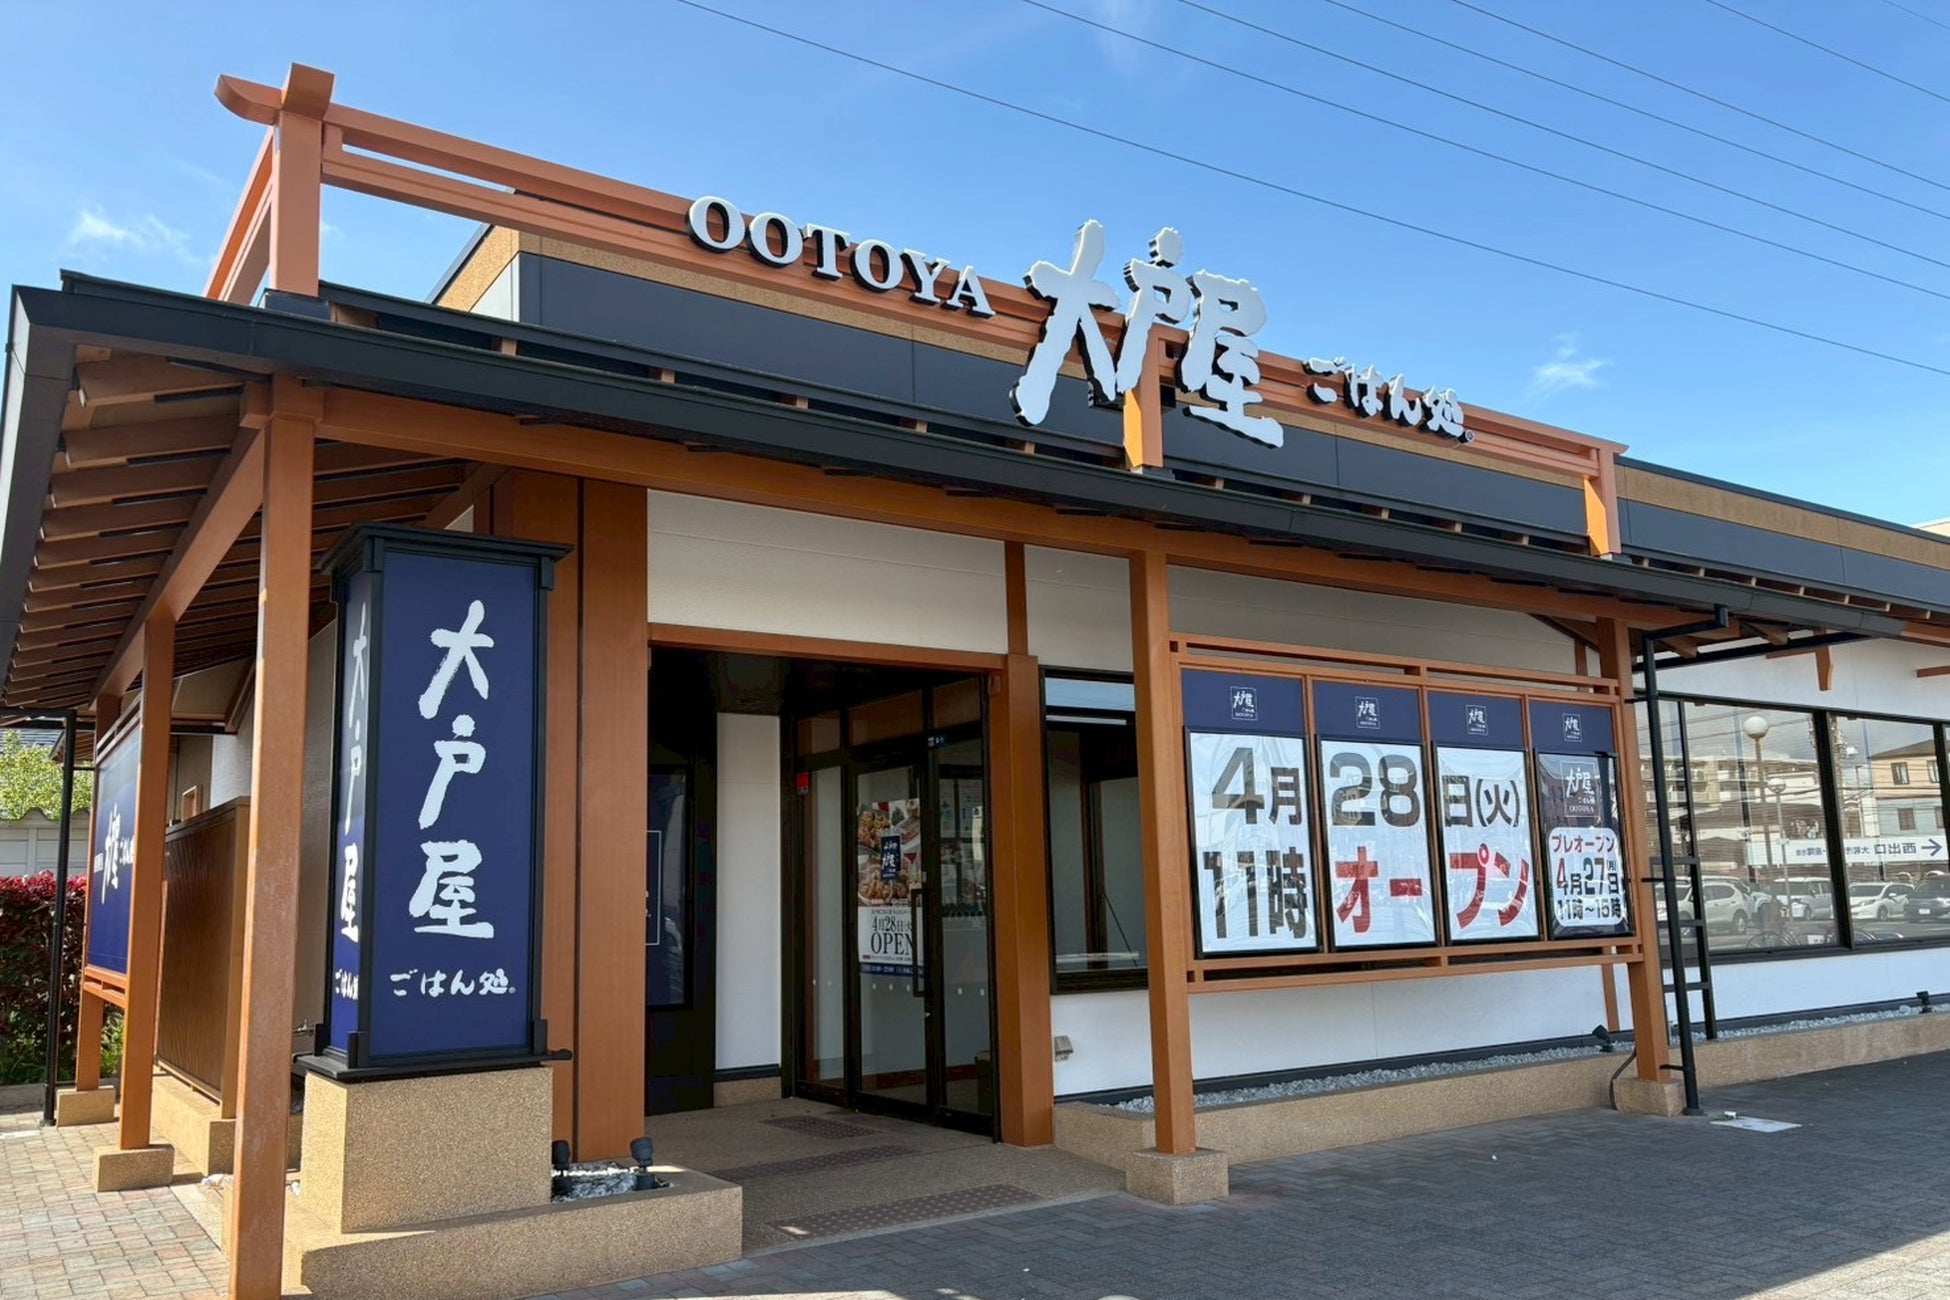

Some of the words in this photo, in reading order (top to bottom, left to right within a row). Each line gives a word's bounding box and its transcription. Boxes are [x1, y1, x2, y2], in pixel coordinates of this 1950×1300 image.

[687, 195, 996, 318] OOTOYA
[1009, 219, 1284, 448] 大戸屋
[1303, 356, 1466, 438] ごはん処
[340, 601, 367, 943] 大戸屋
[409, 600, 494, 938] 大戸屋
[1211, 747, 1302, 826] 4月
[1329, 752, 1421, 828] 28
[1441, 775, 1520, 828] 日(火)
[1203, 846, 1308, 939] 11時
[1449, 843, 1529, 930] プン
[390, 968, 509, 998] ごはん処
